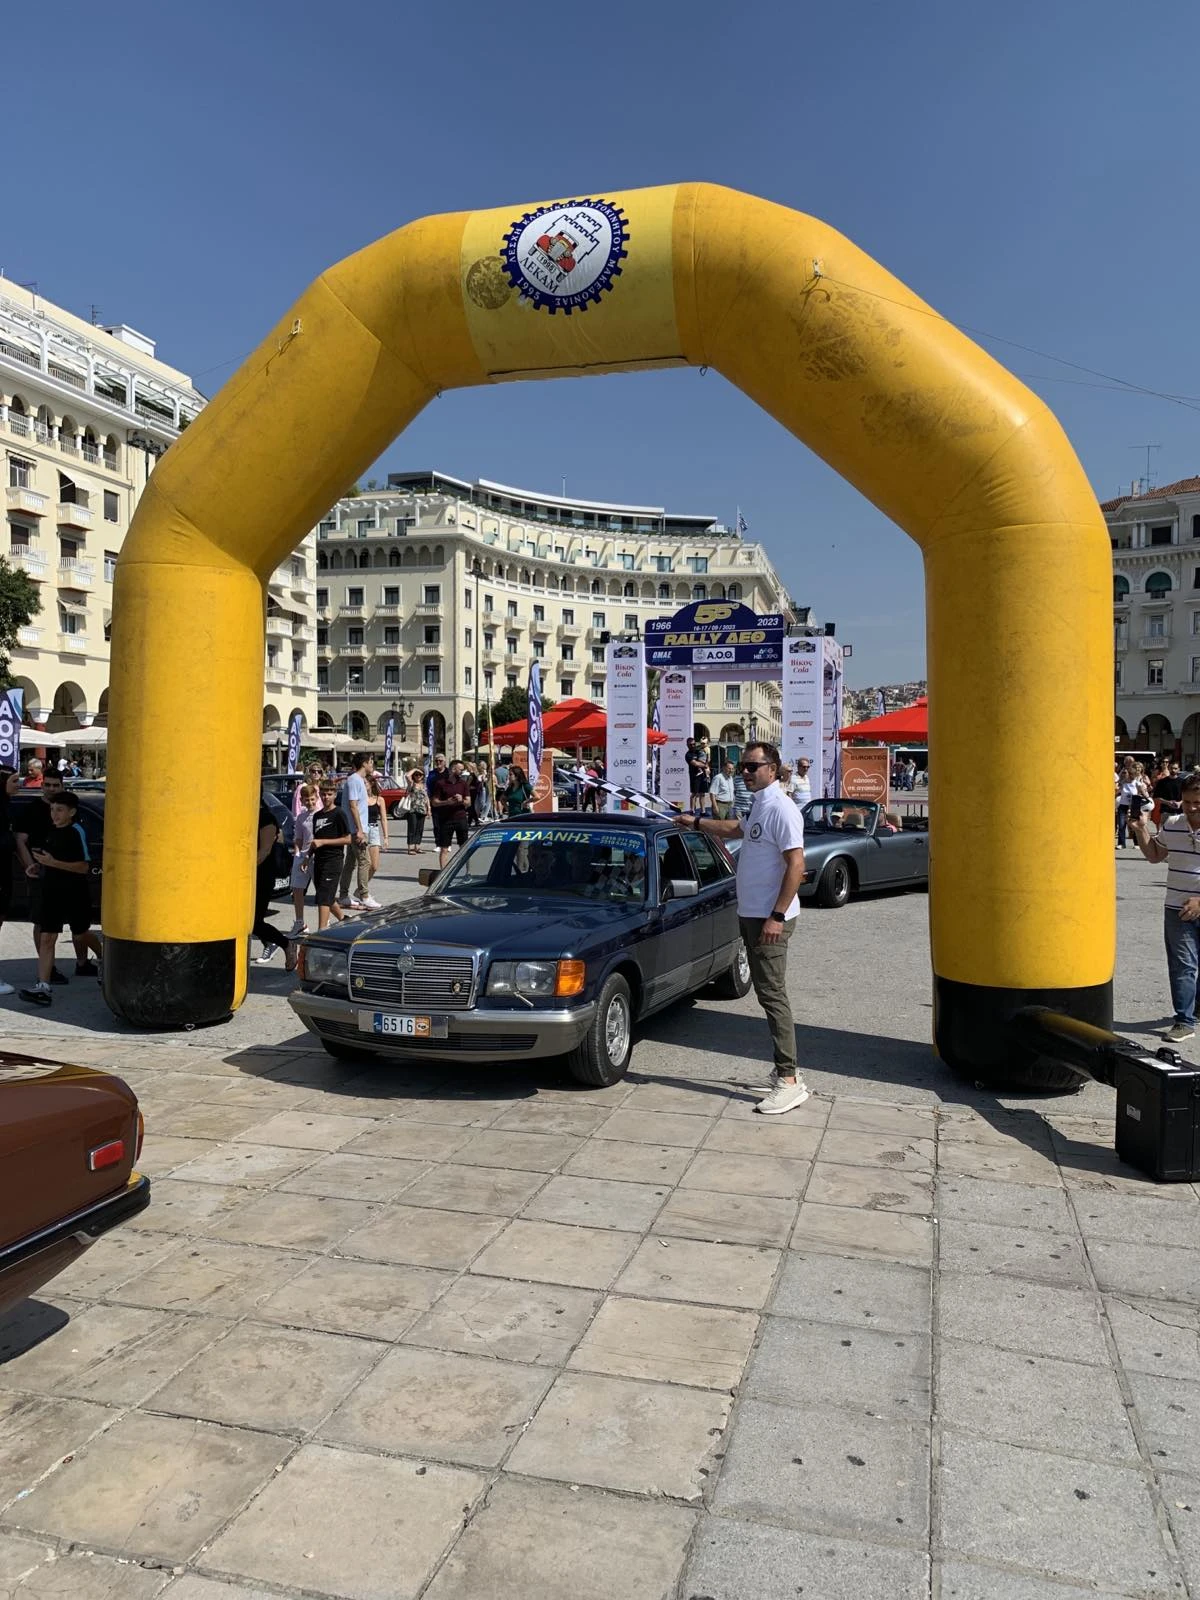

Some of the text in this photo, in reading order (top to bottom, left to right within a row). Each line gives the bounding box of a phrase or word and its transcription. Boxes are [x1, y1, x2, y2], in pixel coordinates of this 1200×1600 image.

[582, 201, 620, 253] ΑΥΤΟΚΙΝΗΤΟΥ
[508, 228, 522, 263] ΛΕΣΧΗ
[520, 256, 560, 294] ΛΕΚΑΜ
[555, 258, 617, 306] ΜΑΚΕΔΟΝΙΑΣ
[516, 277, 540, 300] 1995
[651, 622, 672, 630] 1966
[757, 618, 779, 626] 2023
[664, 631, 766, 645] RALLY ΔΕΘ
[510, 831, 592, 843] ΑΣΛΑΝΗΣ
[383, 1017, 413, 1033] 6516
